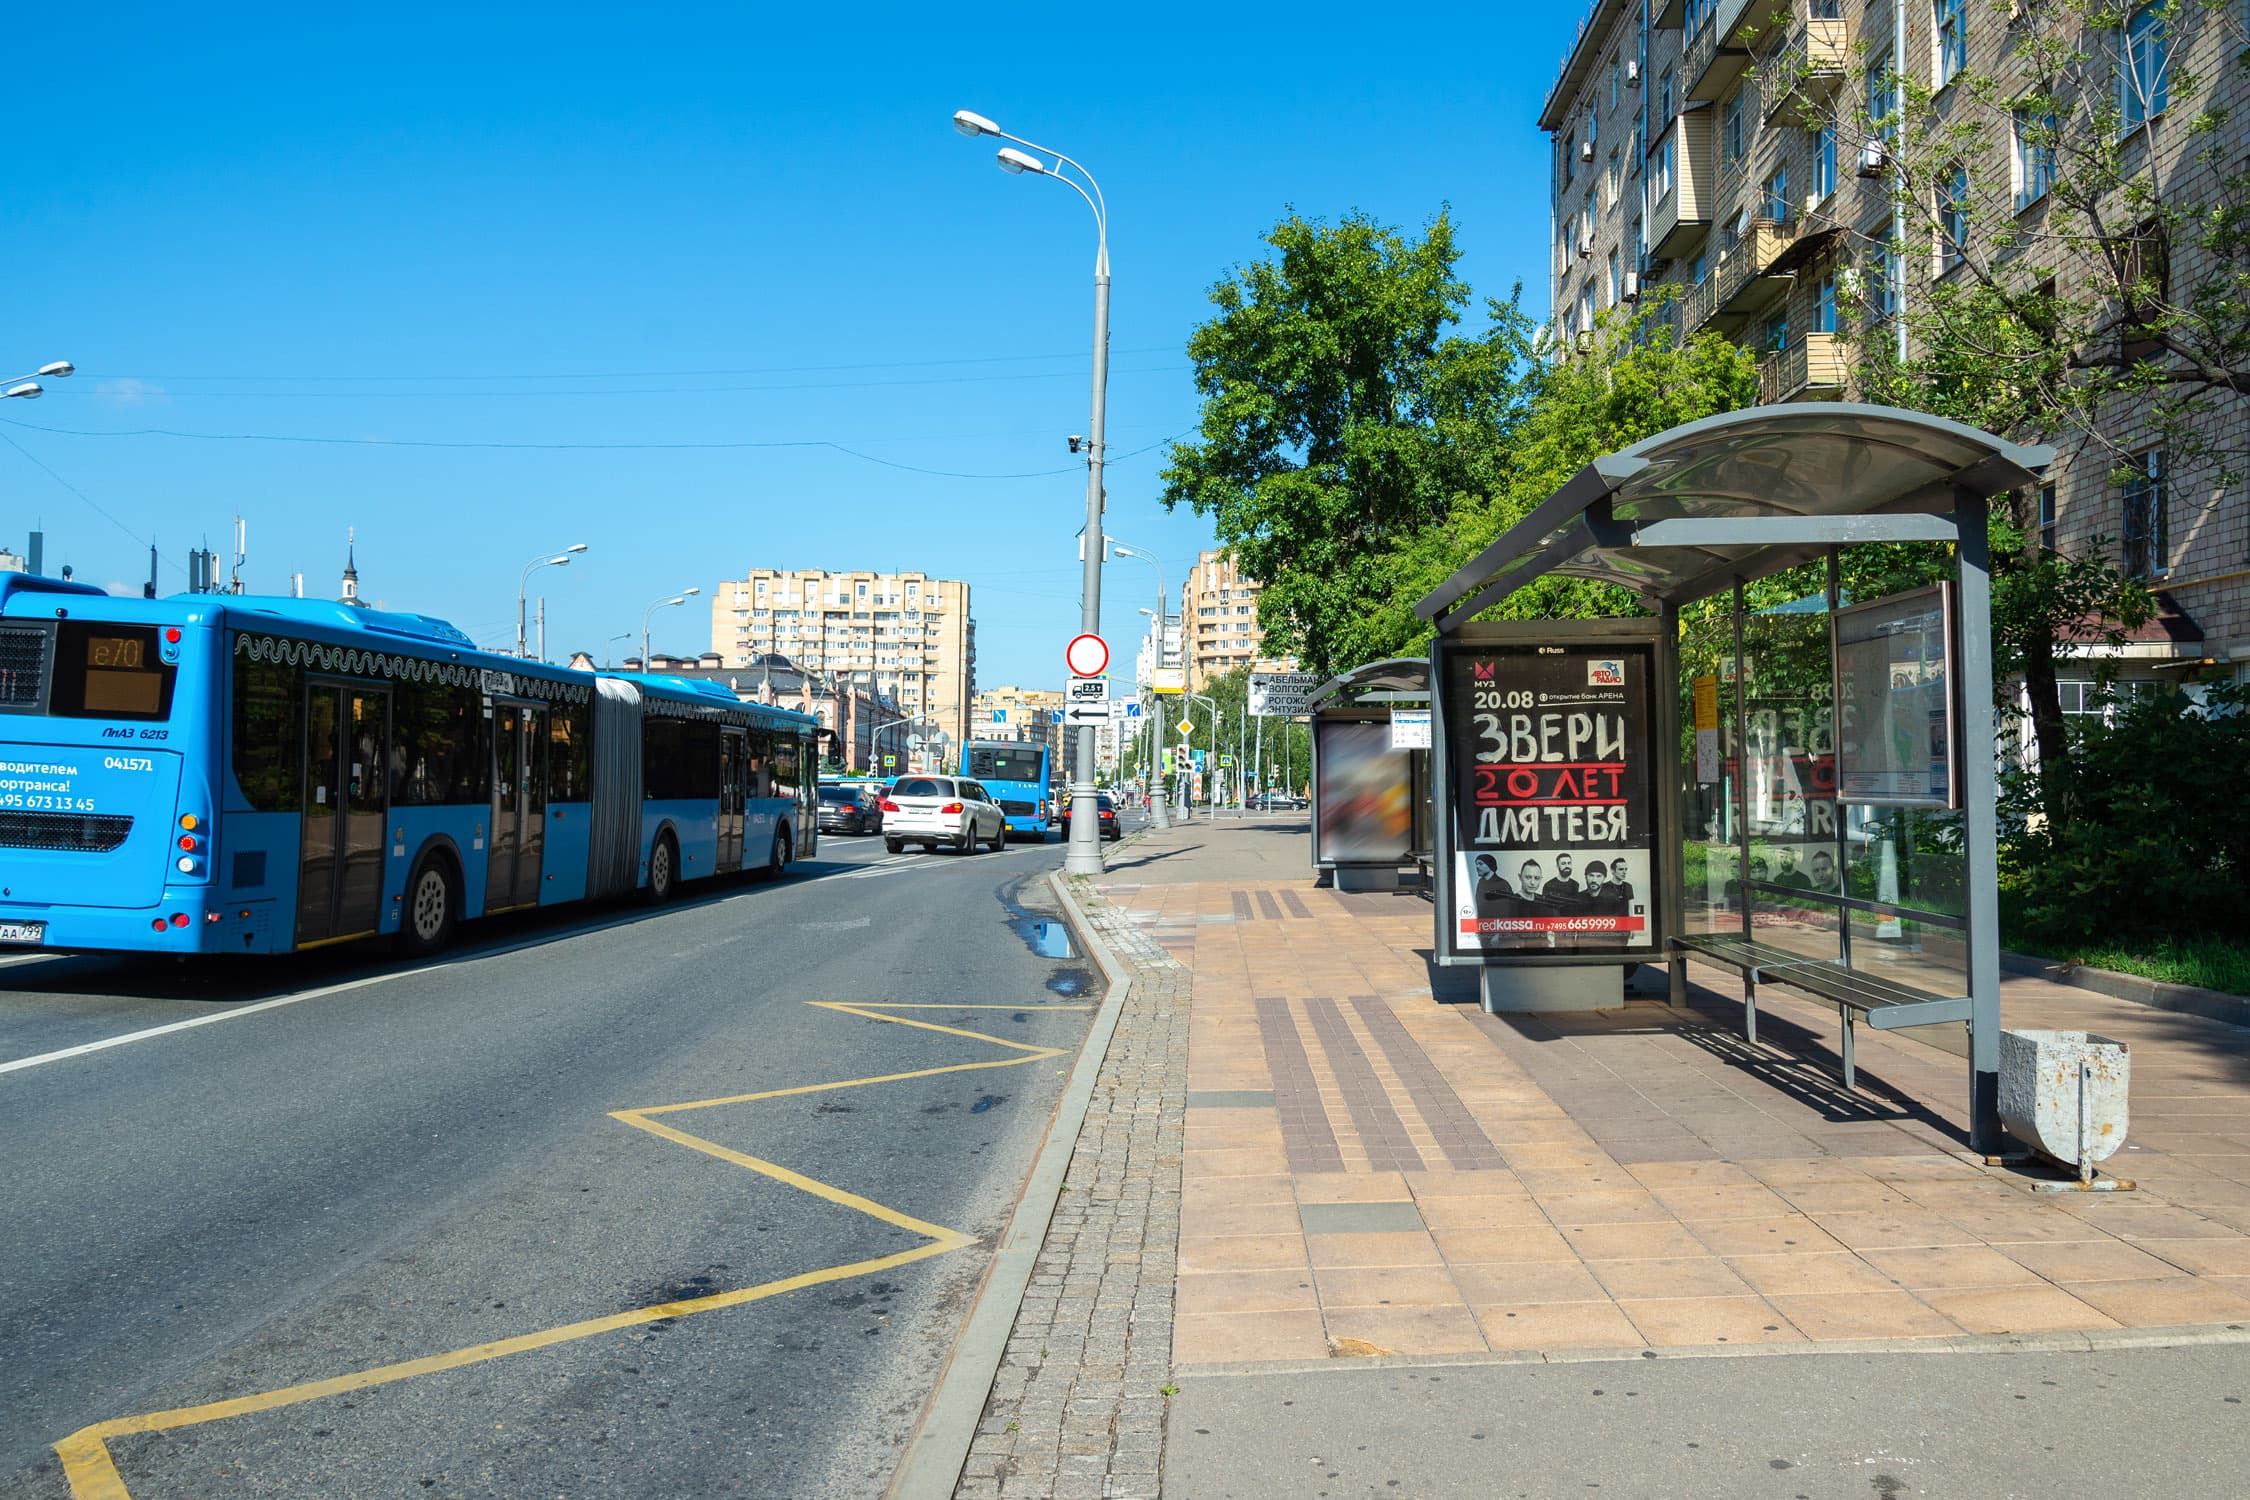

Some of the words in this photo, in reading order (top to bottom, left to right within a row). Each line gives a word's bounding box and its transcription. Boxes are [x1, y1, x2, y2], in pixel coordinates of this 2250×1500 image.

[1591, 670, 1611, 678] АВТО
[1596, 676, 1622, 684] РАДИО
[1474, 690, 1534, 709] 20.08
[1549, 693, 1580, 701] открытие
[1581, 692, 1597, 700] банк
[1598, 692, 1624, 700] АРЕНА
[139, 729, 169, 740] 6213
[1473, 713, 1625, 763] ЗВЕРИ
[0, 762, 78, 775] водителем
[104, 756, 153, 771] 041571
[1475, 768, 1539, 798] 20
[1551, 768, 1625, 798] ЛЕТ
[26, 795, 52, 809] 673
[56, 797, 72, 810] 13
[76, 799, 95, 811] 45
[1474, 806, 1539, 844] ДЛЯ
[1544, 806, 1627, 842] ТЕБЯ
[1478, 919, 1544, 931] redkassa.ru
[1546, 923, 1567, 931] +7495
